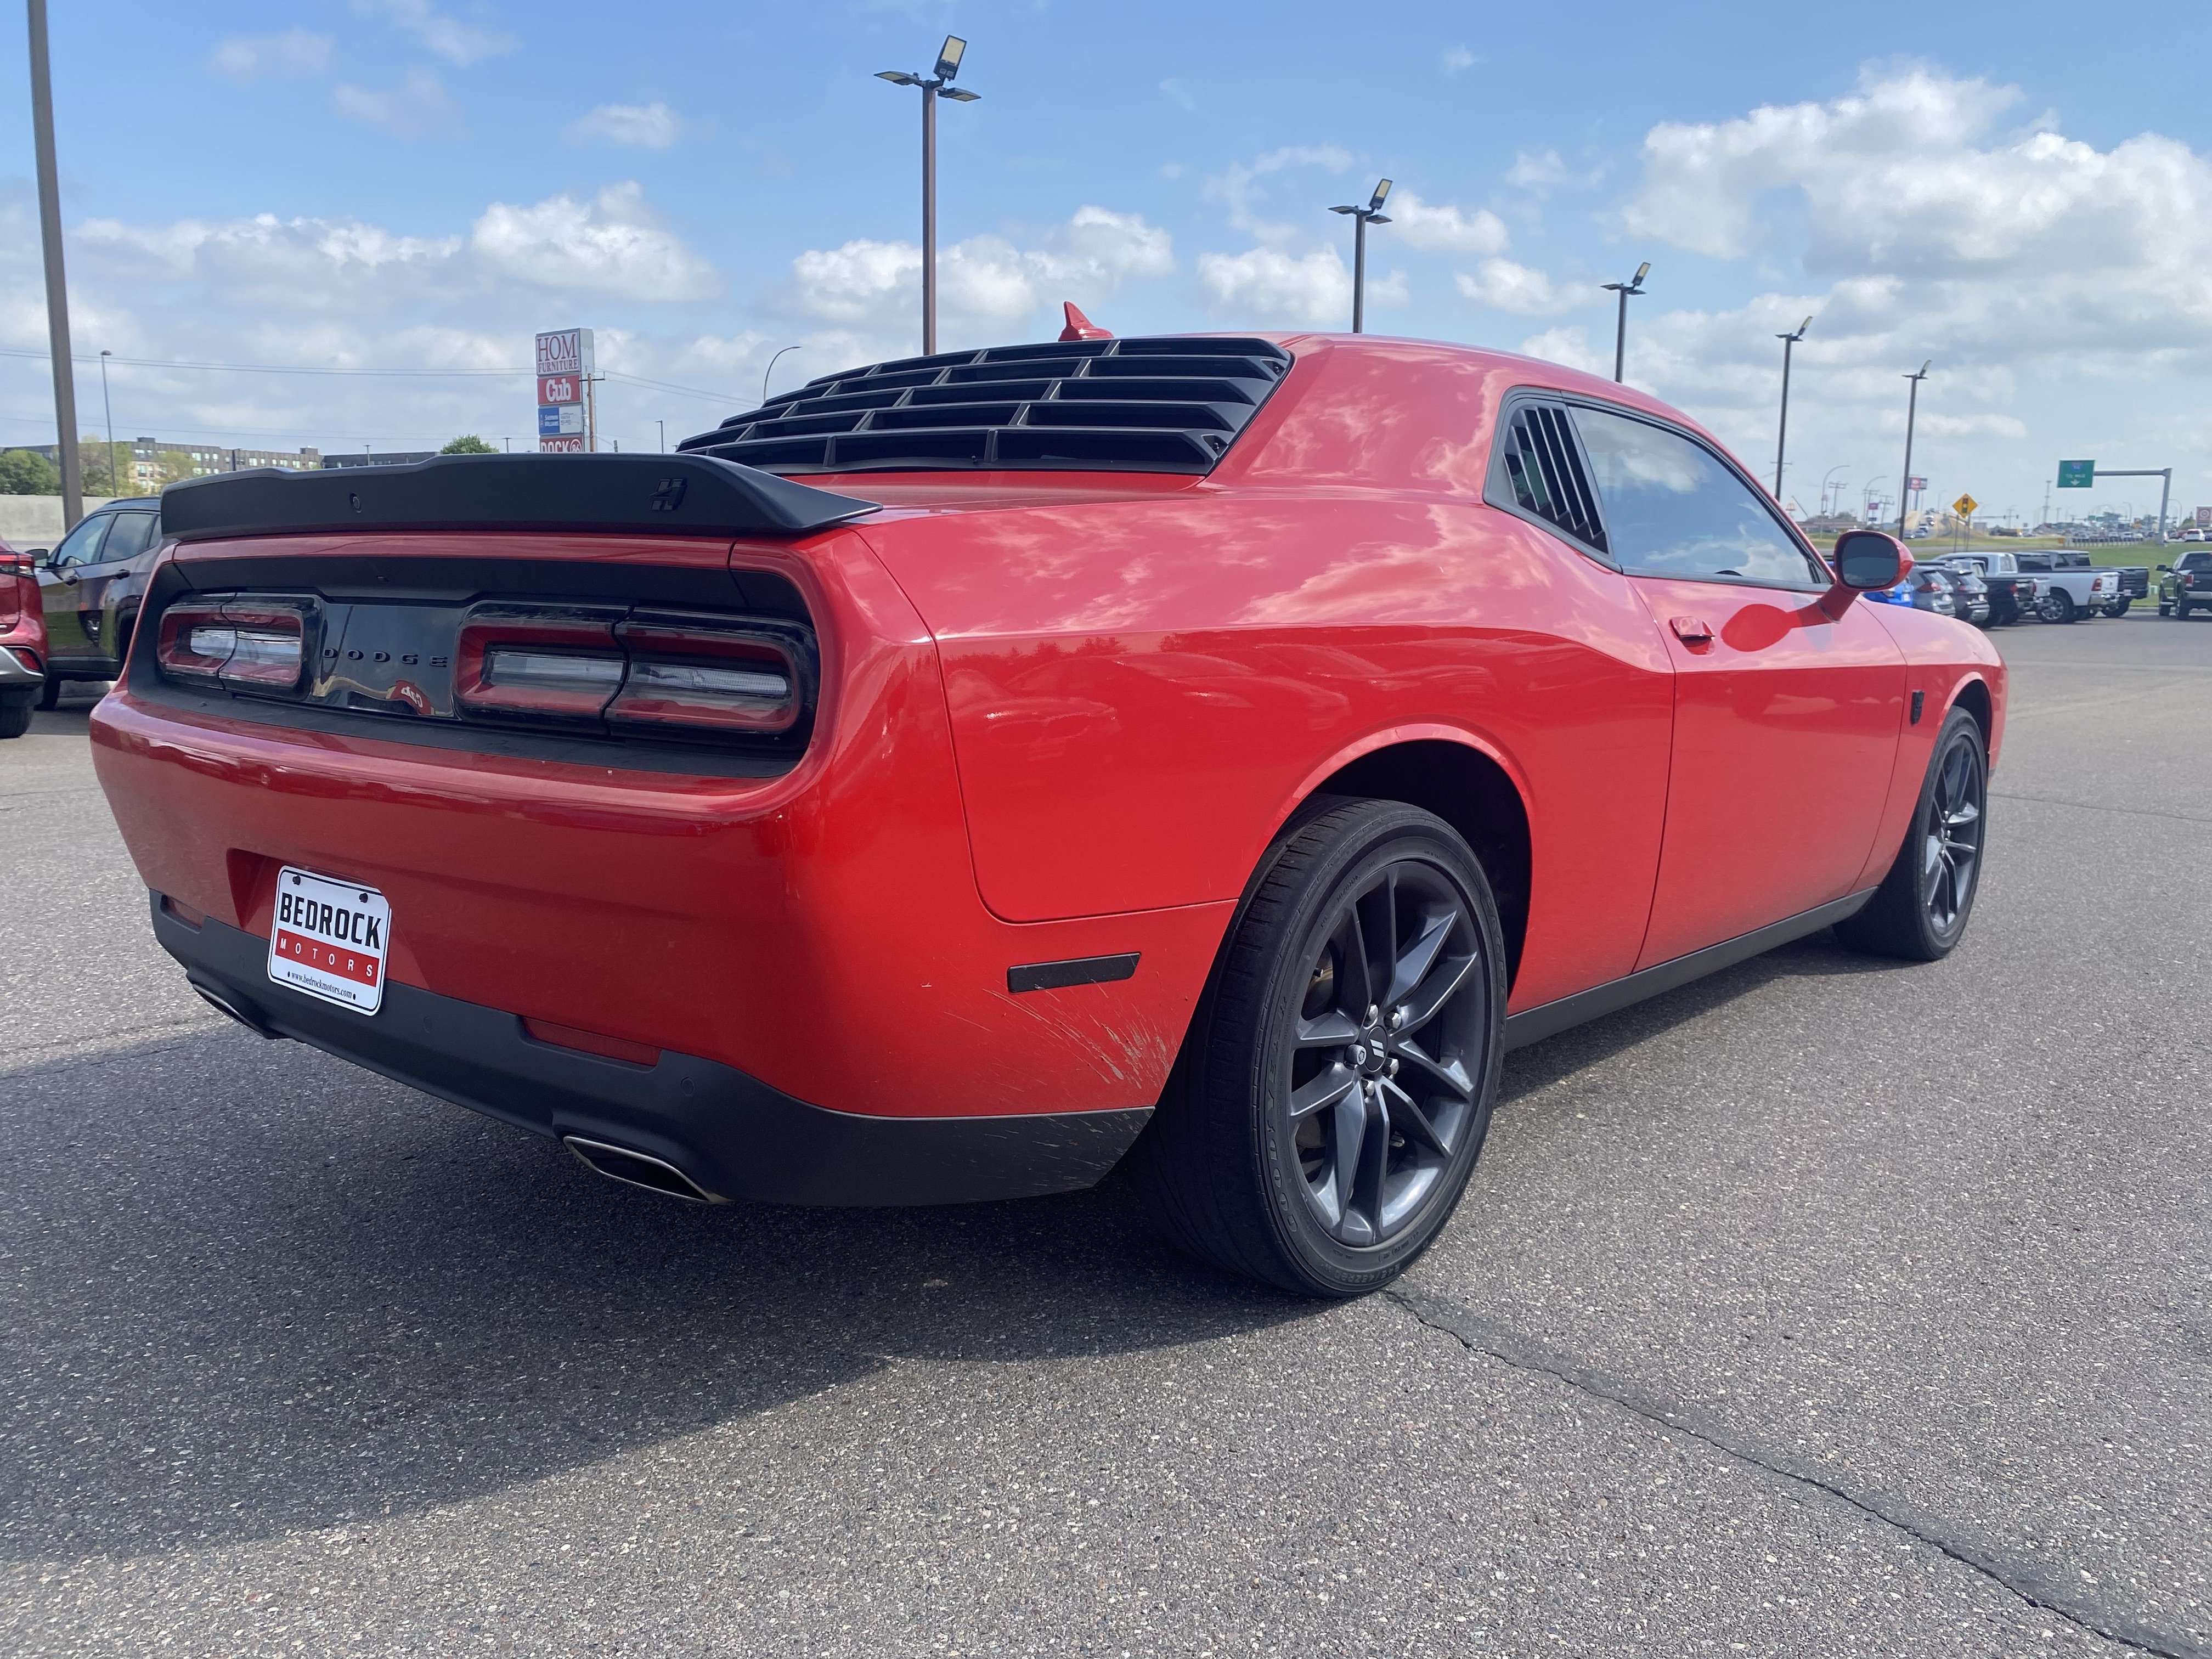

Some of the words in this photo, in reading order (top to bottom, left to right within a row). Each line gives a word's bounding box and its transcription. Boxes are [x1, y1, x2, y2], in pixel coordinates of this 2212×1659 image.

[538, 334, 577, 362] HOM
[538, 359, 578, 373] FURNITURE
[546, 378, 572, 402] Cub
[324, 648, 448, 668] DODGE
[279, 893, 382, 950] BEDROCK
[280, 938, 373, 977] MOTORS
[291, 972, 352, 999] www.bedrockmotors.com
